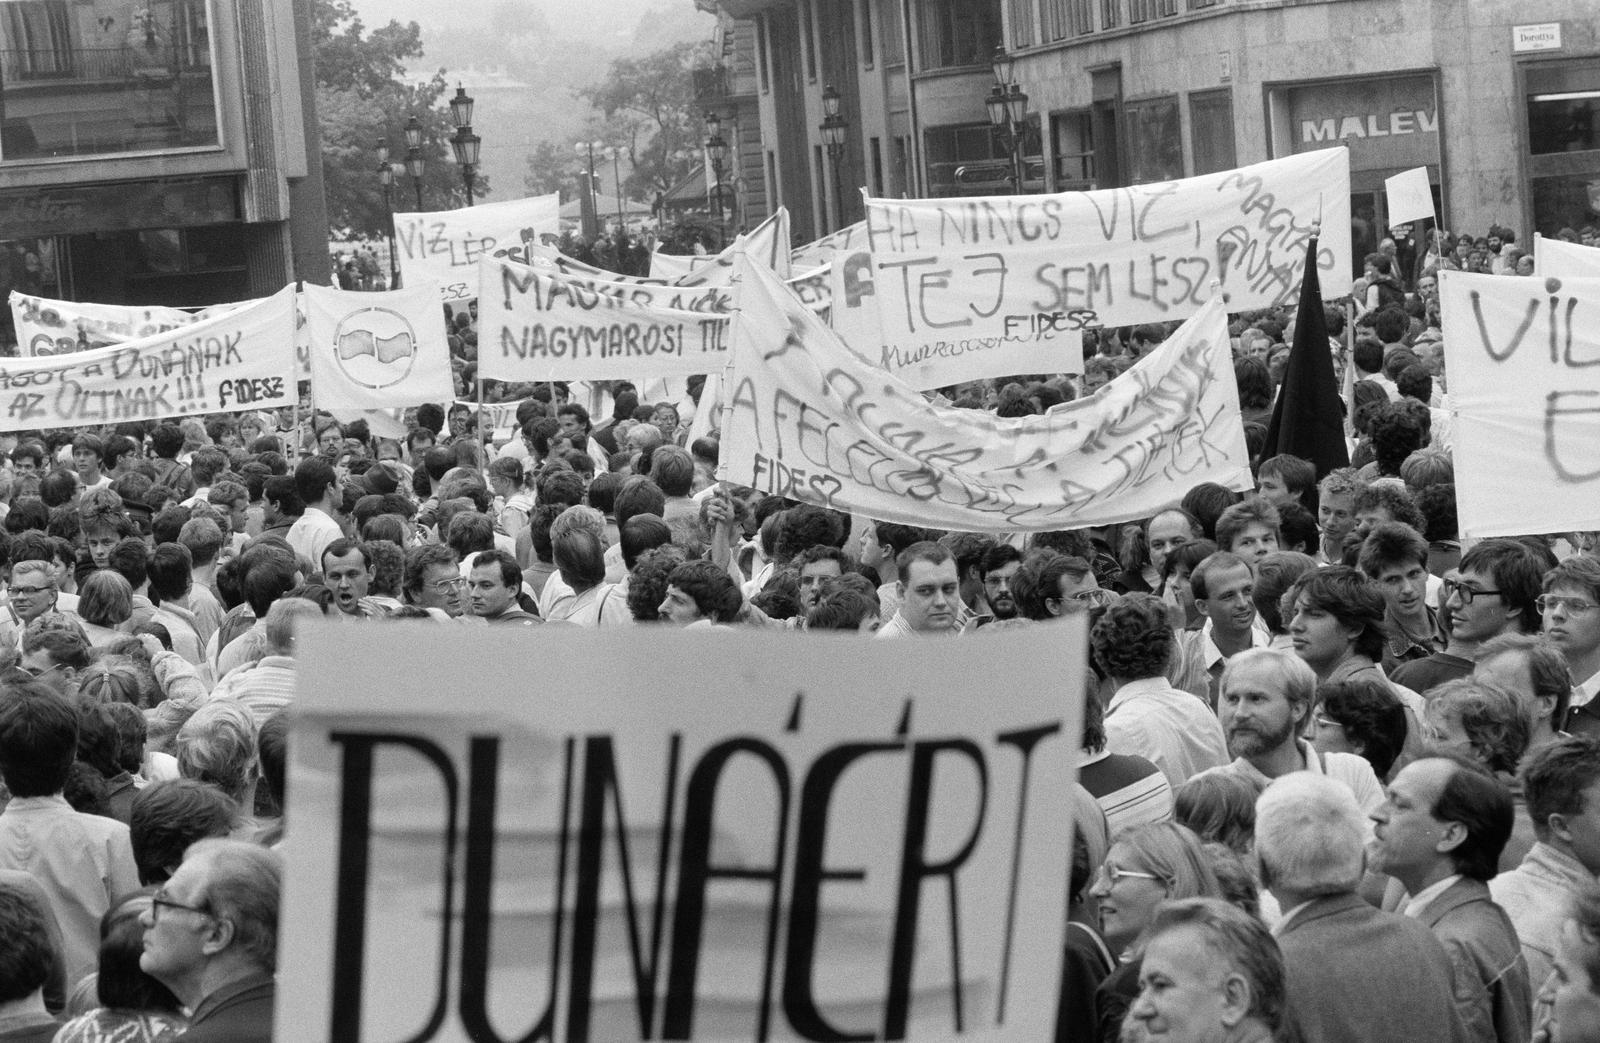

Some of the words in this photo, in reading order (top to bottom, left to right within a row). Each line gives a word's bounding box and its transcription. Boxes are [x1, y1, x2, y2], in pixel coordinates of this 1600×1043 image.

[866, 202, 920, 253] HA
[937, 199, 1062, 245] NINCS
[878, 253, 1008, 334] TEJ
[1032, 262, 1113, 312] SEM
[500, 322, 684, 359] NAGYMAROSI
[1004, 310, 1105, 337] FIDESZ
[82, 364, 103, 378] A
[8, 392, 47, 421] AZ
[219, 376, 285, 408] FIDESZ
[328, 693, 1064, 1043] DUNÁÉRT
